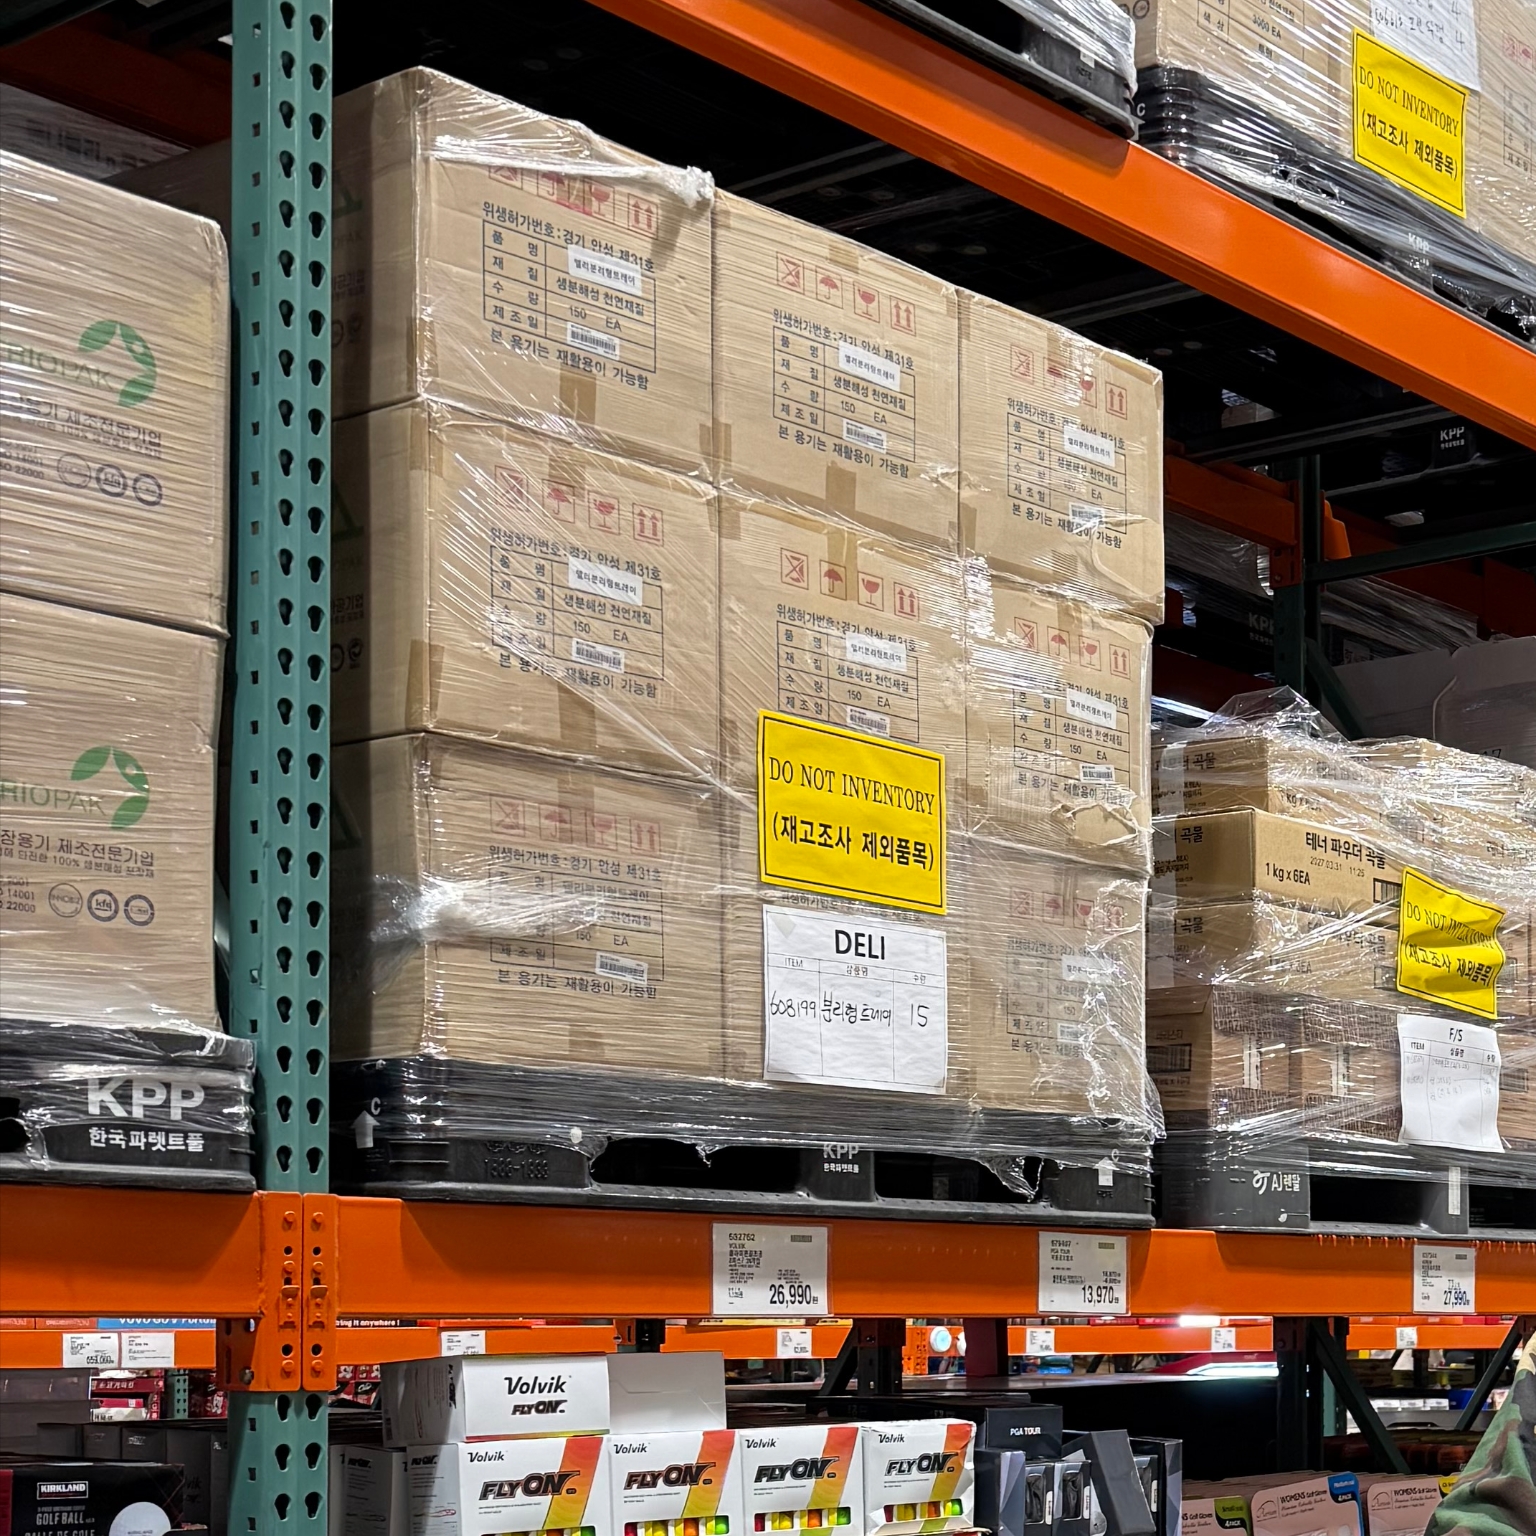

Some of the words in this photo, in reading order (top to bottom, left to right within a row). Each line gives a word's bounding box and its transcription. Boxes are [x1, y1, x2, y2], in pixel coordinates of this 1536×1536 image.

[1360, 66, 1374, 90] DO
[1378, 76, 1399, 103] NOT
[1402, 90, 1459, 137] INVENTORY
[1362, 109, 1408, 154] (재고조사
[1414, 139, 1458, 181] 제외품목)
[569, 305, 587, 320] 150
[605, 317, 623, 332] EA
[612, 365, 649, 391] 가능함
[841, 400, 856, 414] 150
[874, 412, 888, 425] EA
[1440, 426, 1465, 441] KPP
[573, 620, 591, 634] 150
[613, 630, 629, 644] EA
[847, 690, 862, 701] 150
[877, 696, 891, 709] EA
[1070, 744, 1082, 755] 150
[1096, 750, 1108, 761] EA
[769, 757, 794, 784] DO
[800, 764, 835, 793] NOT
[842, 773, 935, 815] INVENTORY
[773, 811, 852, 854] (재고조사
[862, 832, 934, 872] 제외품목)
[1331, 837, 1363, 862] 파우더
[1273, 864, 1284, 882] kg
[1293, 868, 1310, 886] 6EA
[1407, 901, 1421, 922] DO
[1425, 909, 1446, 933] NOT
[613, 934, 630, 947] EA
[835, 929, 885, 960] DELI
[784, 958, 803, 968] ITEM
[770, 990, 816, 1018] 608199
[910, 1003, 930, 1027] 15
[1449, 1027, 1463, 1042] F/S
[87, 1076, 206, 1121] KPP
[370, 1096, 381, 1116] C
[88, 1127, 205, 1153] 한국파렛트풀
[823, 1143, 859, 1160] KPP
[504, 1375, 567, 1395] Volvik
[1010, 1427, 1023, 1436] PGA
[1024, 1426, 1041, 1435] TOUR
[613, 1443, 648, 1455] Volvik
[745, 1438, 777, 1449] Volvik
[467, 1450, 505, 1463] Volvik
[41, 1484, 86, 1493] KIRKLAND
[36, 1513, 59, 1526] GOLF
[62, 1512, 84, 1524] BALL
